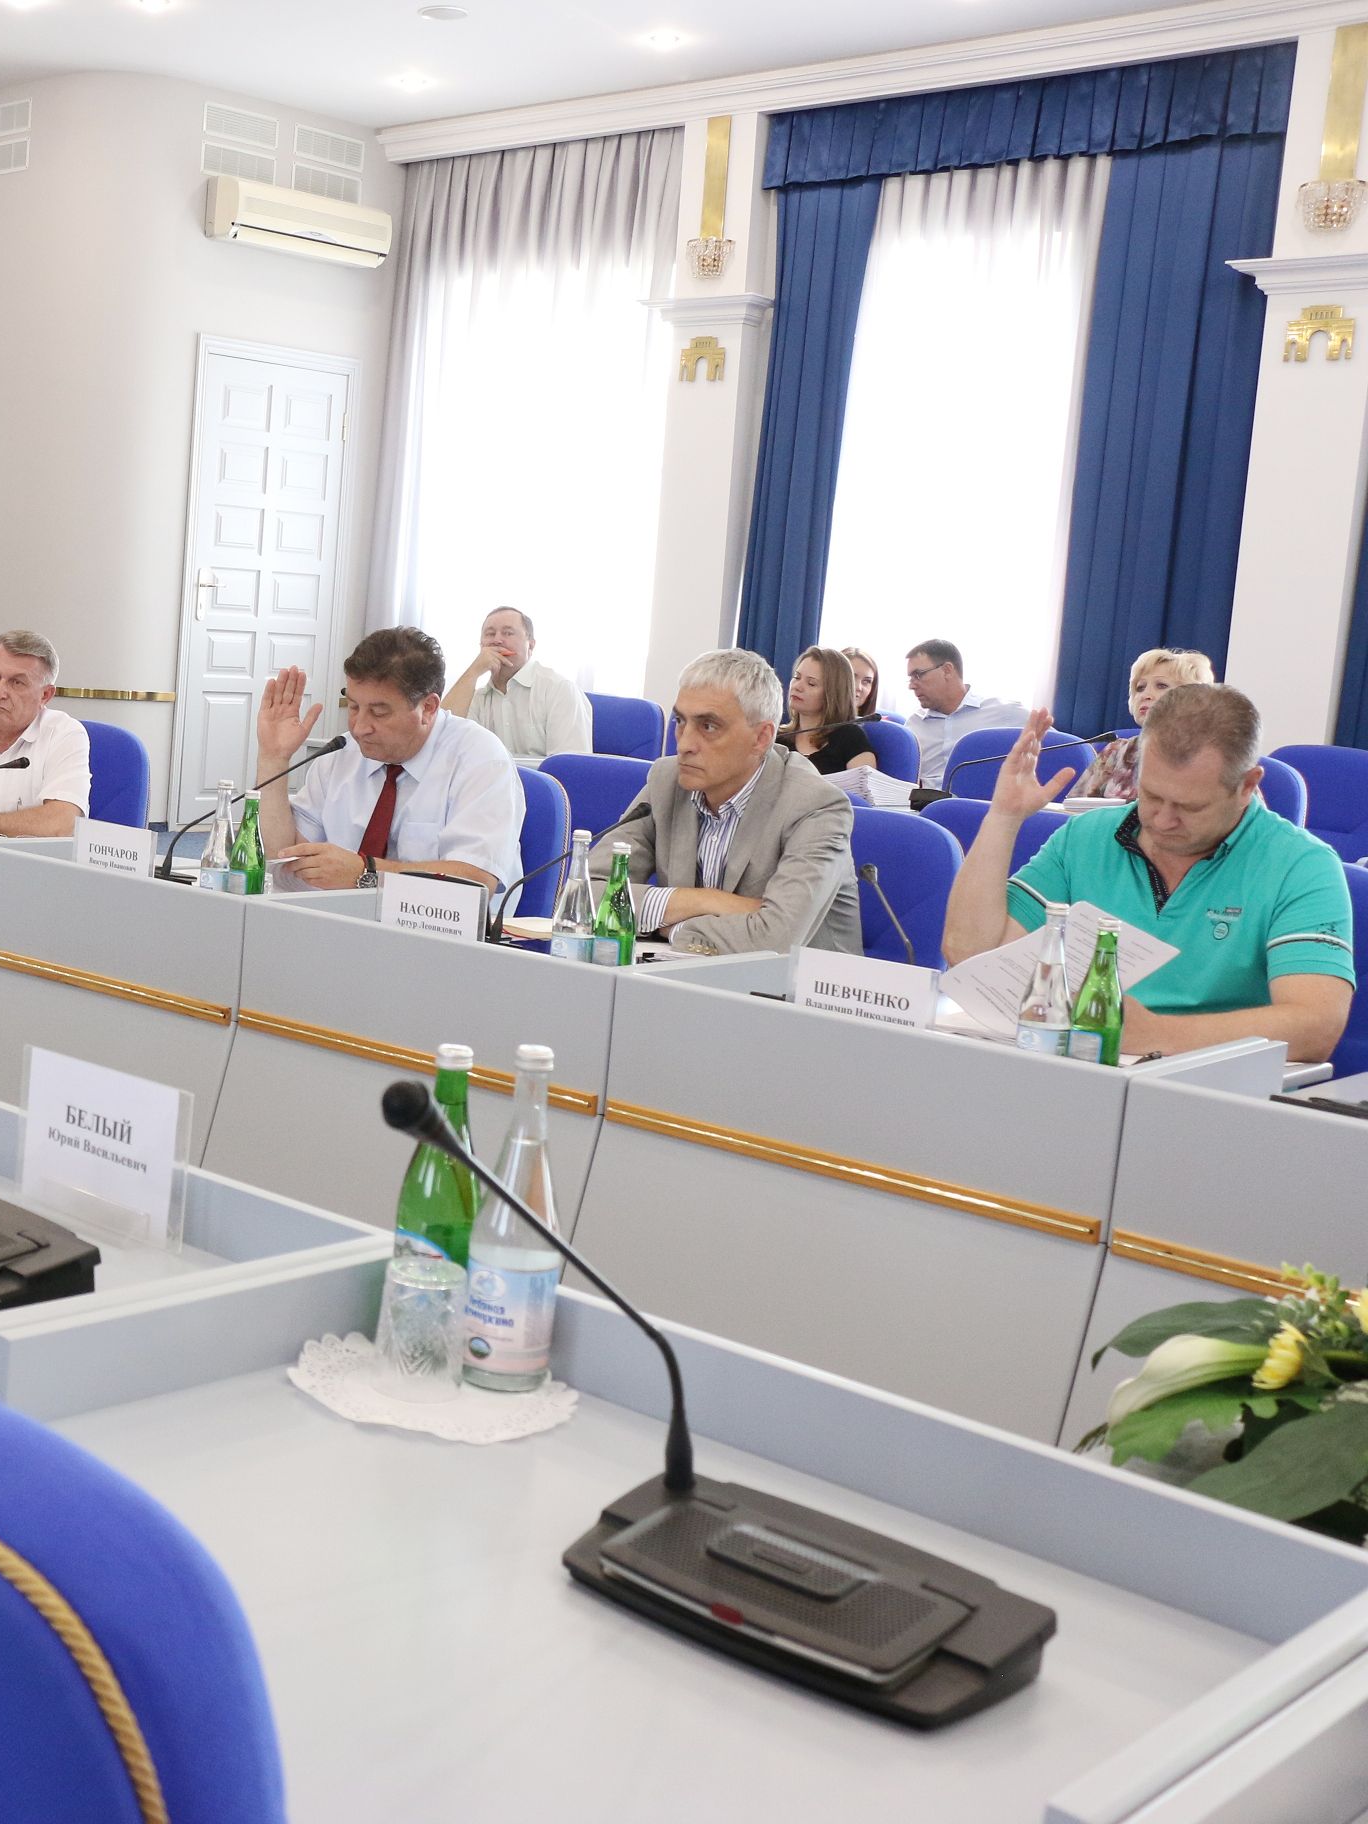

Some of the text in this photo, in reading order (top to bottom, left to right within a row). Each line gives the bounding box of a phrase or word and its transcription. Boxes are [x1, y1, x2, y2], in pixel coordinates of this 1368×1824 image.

[89, 843, 138, 861] ГОНЧАРОВ
[400, 901, 461, 922] НАСОНОВ
[396, 917, 463, 936] Артур Леонидович
[814, 980, 910, 1011] ШЕВЧЕНКО
[855, 1007, 915, 1027] Николаевич
[66, 1104, 133, 1145] БЕЛЫЙ
[48, 1126, 148, 1173] Юрий Васильевич
